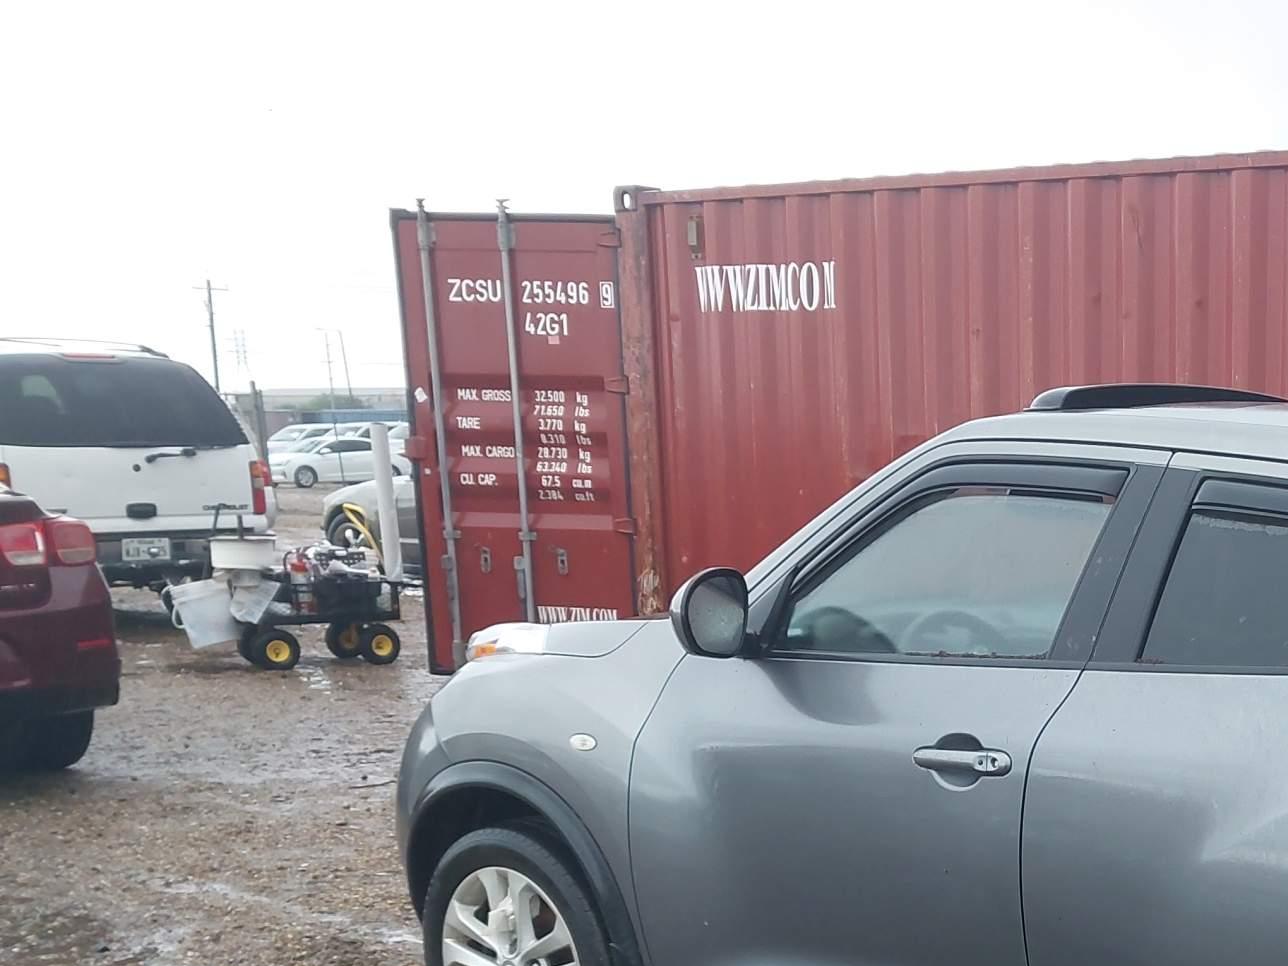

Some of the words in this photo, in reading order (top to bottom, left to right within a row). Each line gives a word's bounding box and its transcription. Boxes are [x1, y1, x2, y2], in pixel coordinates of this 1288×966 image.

[447, 278, 502, 302] ZCSU
[521, 281, 589, 304] 255496
[601, 283, 612, 306] 9
[525, 312, 568, 336] 42G1
[457, 388, 479, 401] MAX.
[481, 389, 512, 402] GROSS
[535, 390, 565, 402] 32.500
[576, 392, 588, 405] kg
[534, 405, 565, 416] 71.650
[575, 406, 590, 417] lbs
[456, 417, 480, 429] TARE
[539, 419, 563, 431] 3.770
[574, 421, 586, 433] kg
[461, 445, 483, 457] MAX.
[486, 446, 515, 458] CARGO
[579, 449, 591, 462] kg
[577, 463, 592, 473] lbs
[478, 474, 498, 486] CAP.
[541, 476, 560, 488] 67.5
